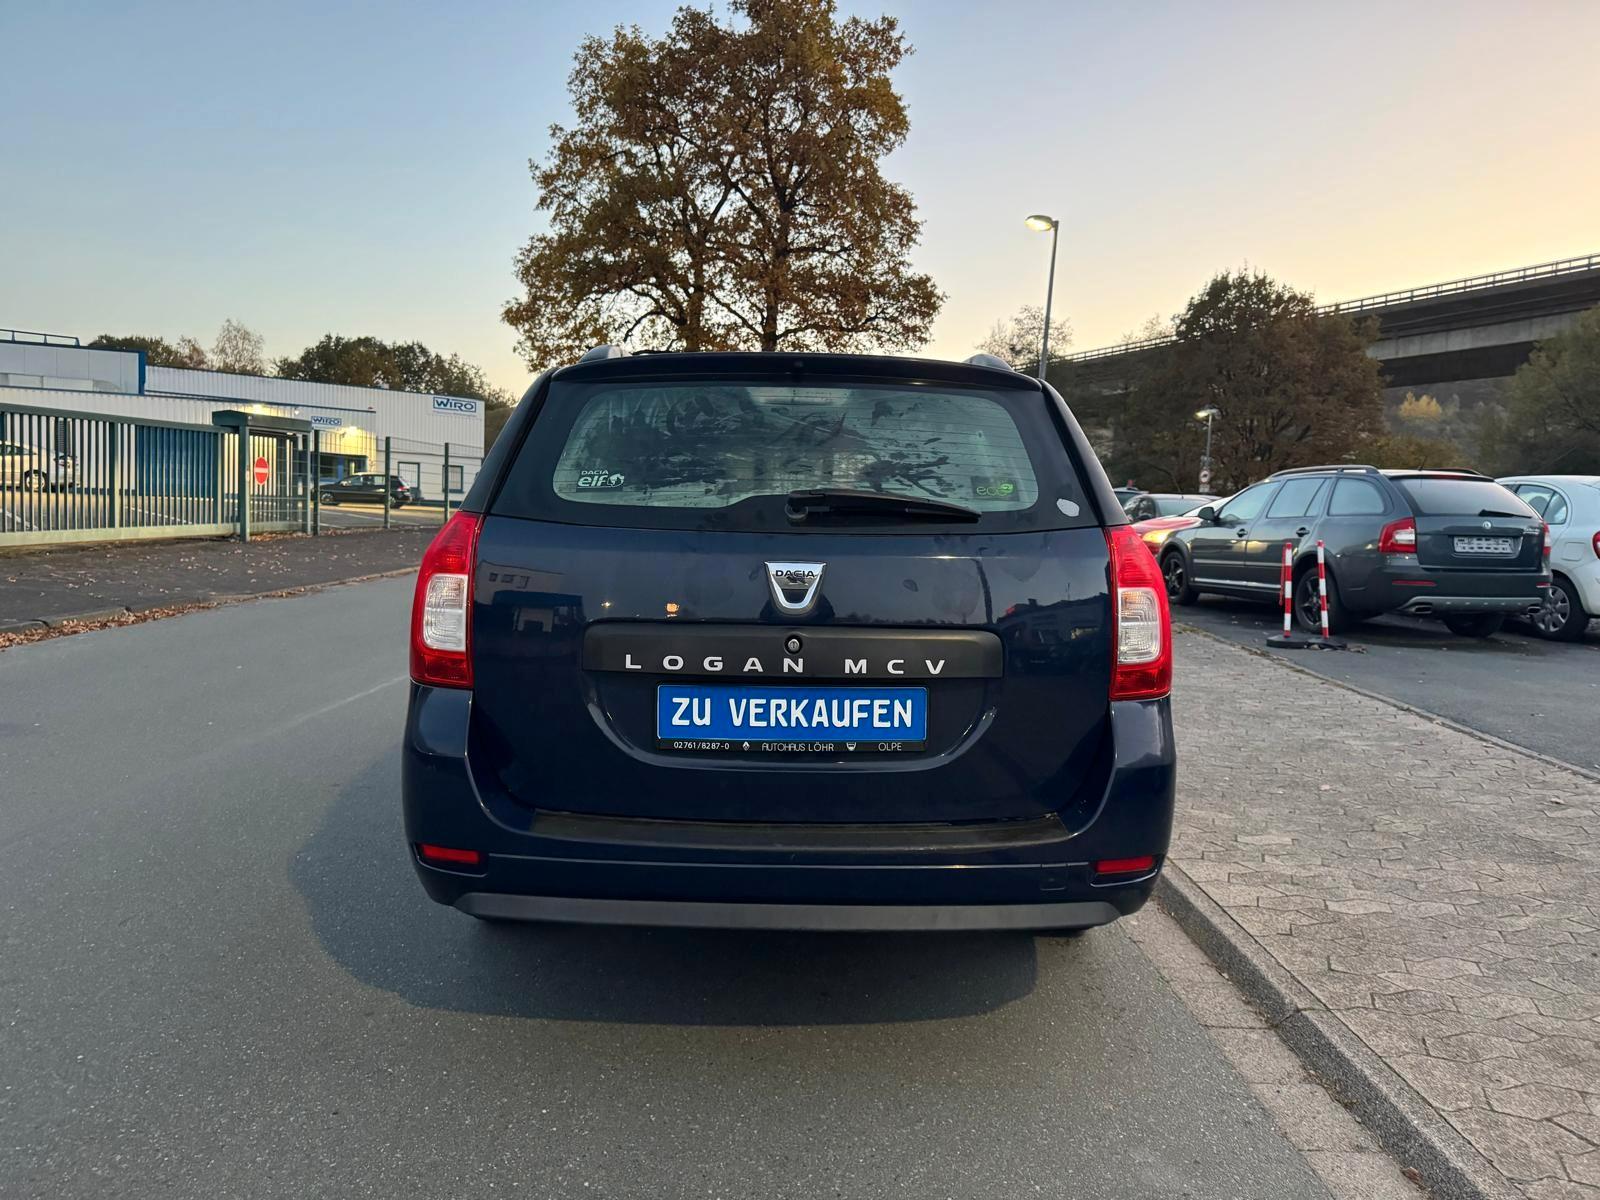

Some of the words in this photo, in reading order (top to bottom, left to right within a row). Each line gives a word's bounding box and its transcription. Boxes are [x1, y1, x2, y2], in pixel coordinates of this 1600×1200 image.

[435, 398, 474, 411] WIRO
[577, 475, 609, 487] elf
[625, 654, 804, 673] LOGAN
[844, 659, 945, 675] MCV
[671, 697, 711, 726] ZU
[729, 698, 912, 728] VERKAUFEN
[673, 741, 730, 750] 02761/8287-0
[761, 742, 805, 752] AUTOHAUS
[808, 742, 834, 752] LÖHR
[878, 742, 902, 751] OLPE
